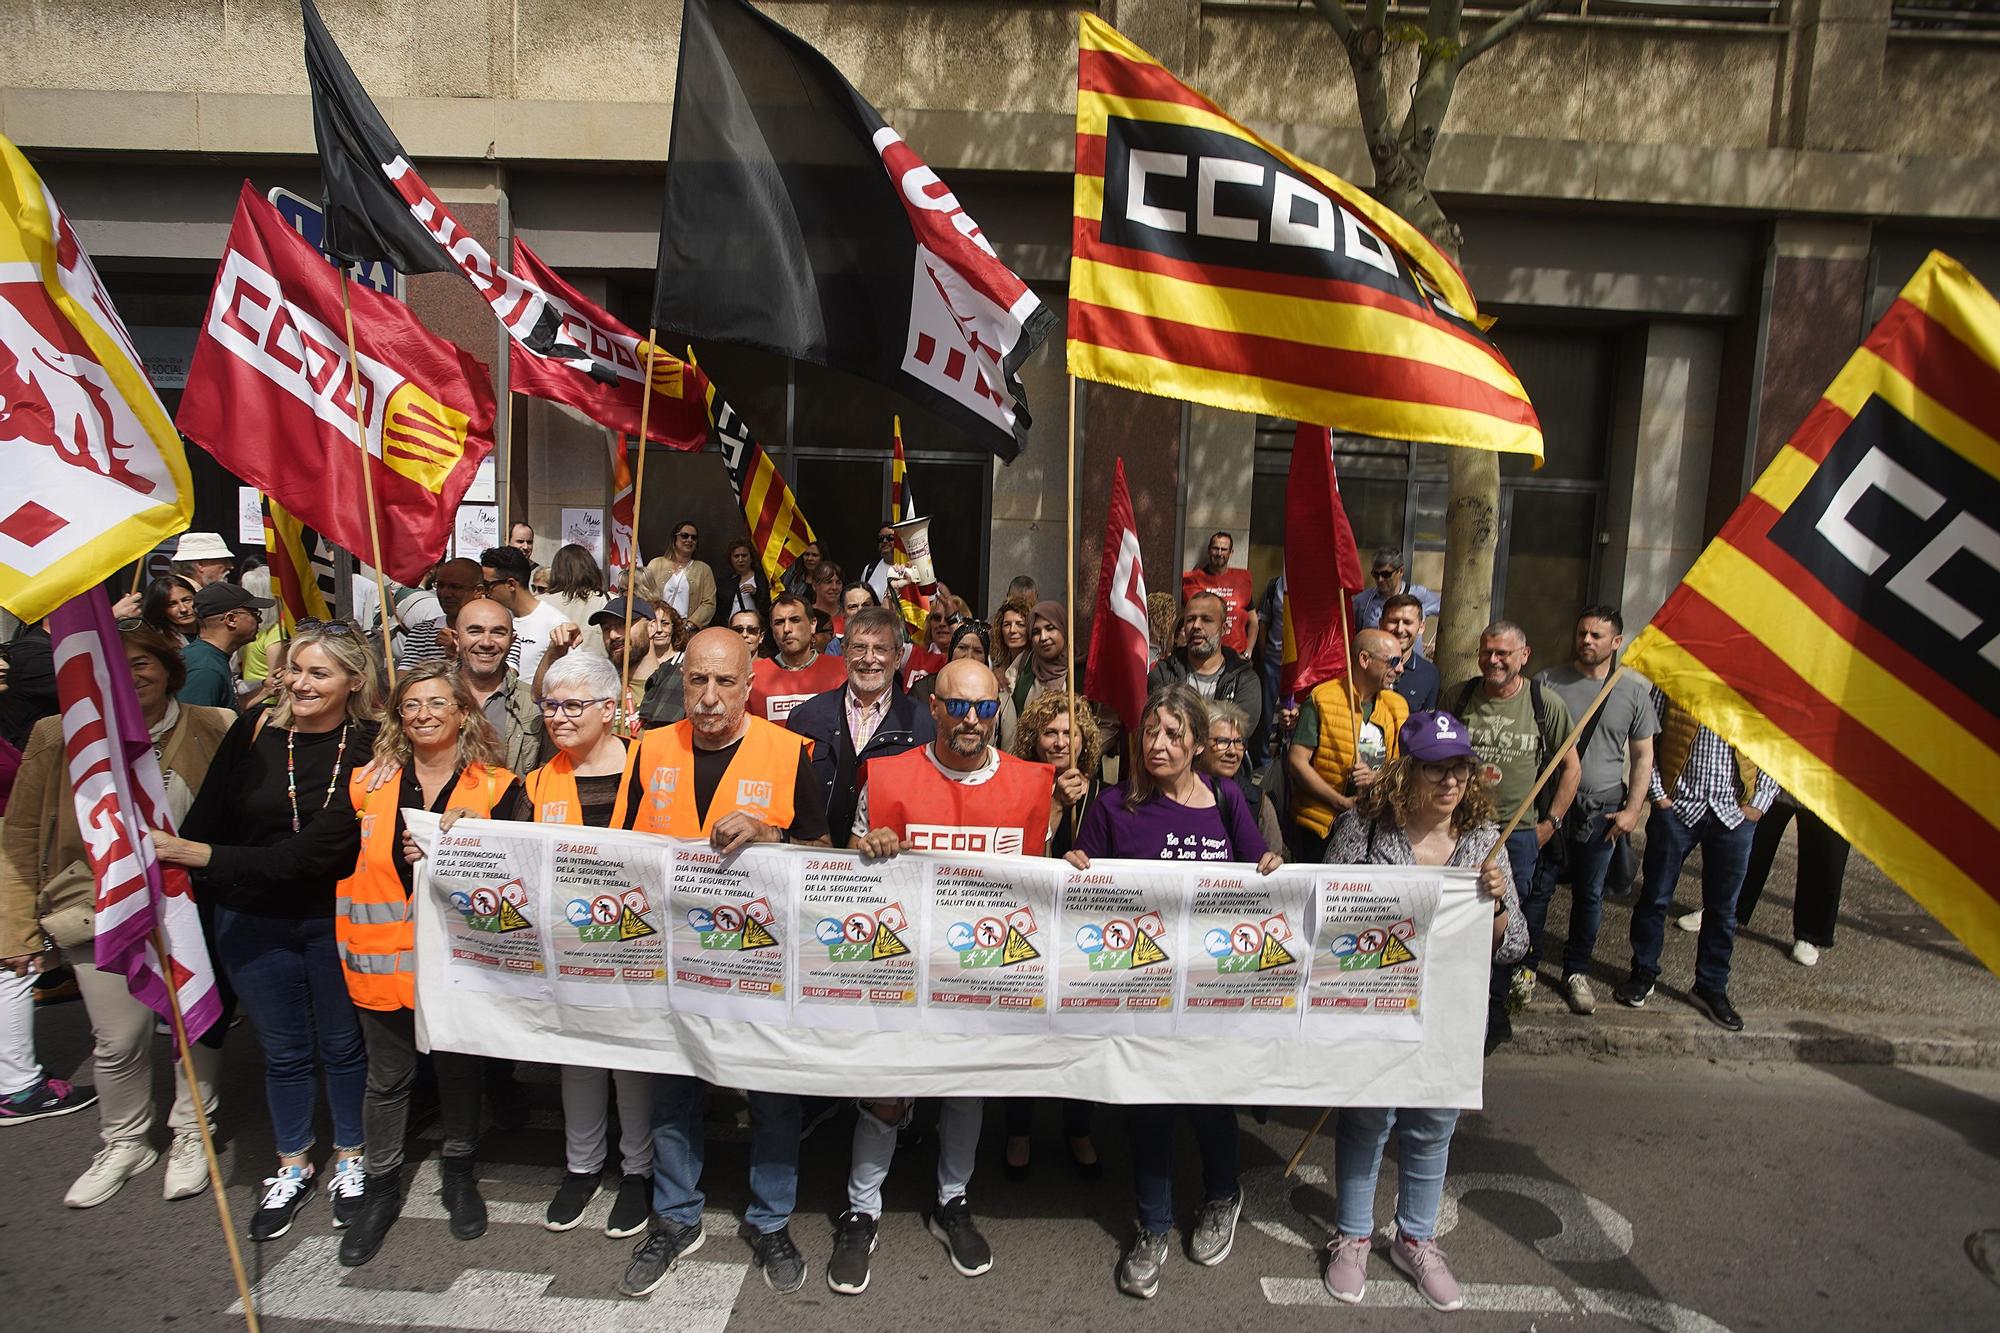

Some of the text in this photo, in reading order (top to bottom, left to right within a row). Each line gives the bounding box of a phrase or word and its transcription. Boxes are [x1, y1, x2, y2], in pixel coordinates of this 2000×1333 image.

[1125, 149, 1399, 278] CCOO
[562, 312, 637, 371] COO
[221, 275, 374, 430] CCOO
[744, 783, 773, 799] UGT
[440, 837, 481, 847] 28 ABRIL
[910, 831, 986, 852] CCOO
[1184, 834, 1197, 846] el
[556, 844, 599, 855] 28 ABRIL
[1160, 847, 1173, 859] de
[1177, 847, 1197, 859] les
[452, 850, 506, 859] INTERNACIONAL
[677, 852, 721, 864] 28 ABRIL
[460, 861, 497, 869] SEGURETAT
[570, 858, 624, 868] INTERNACIONAL
[806, 860, 853, 870] 28 ABRIL
[578, 868, 617, 876] SEGURETAT
[690, 866, 750, 878] INTERNACIONAL
[937, 867, 984, 877] 28 ABRIL
[699, 877, 741, 886] SEGURETAT
[821, 875, 882, 883] INTERNACIONAL
[1068, 874, 1114, 884] 28 ABRIL
[1198, 879, 1244, 888] 28 ABRIL
[830, 885, 873, 893] SEGURETAT
[952, 880, 1013, 889] INTERNACIONAL
[1326, 881, 1372, 892] 28 ABRIL
[724, 889, 754, 898] TREBALL
[1083, 888, 1143, 896] INTERNACIONAL
[987, 900, 1017, 908] TREBALL
[1341, 895, 1400, 904] INTERNACIONAL
[754, 950, 782, 959] 11.30H
[741, 981, 769, 990] CCOO
[872, 991, 900, 999] CCOO
[1001, 997, 1030, 1005] CCOO
[1376, 999, 1405, 1007] CCOO
